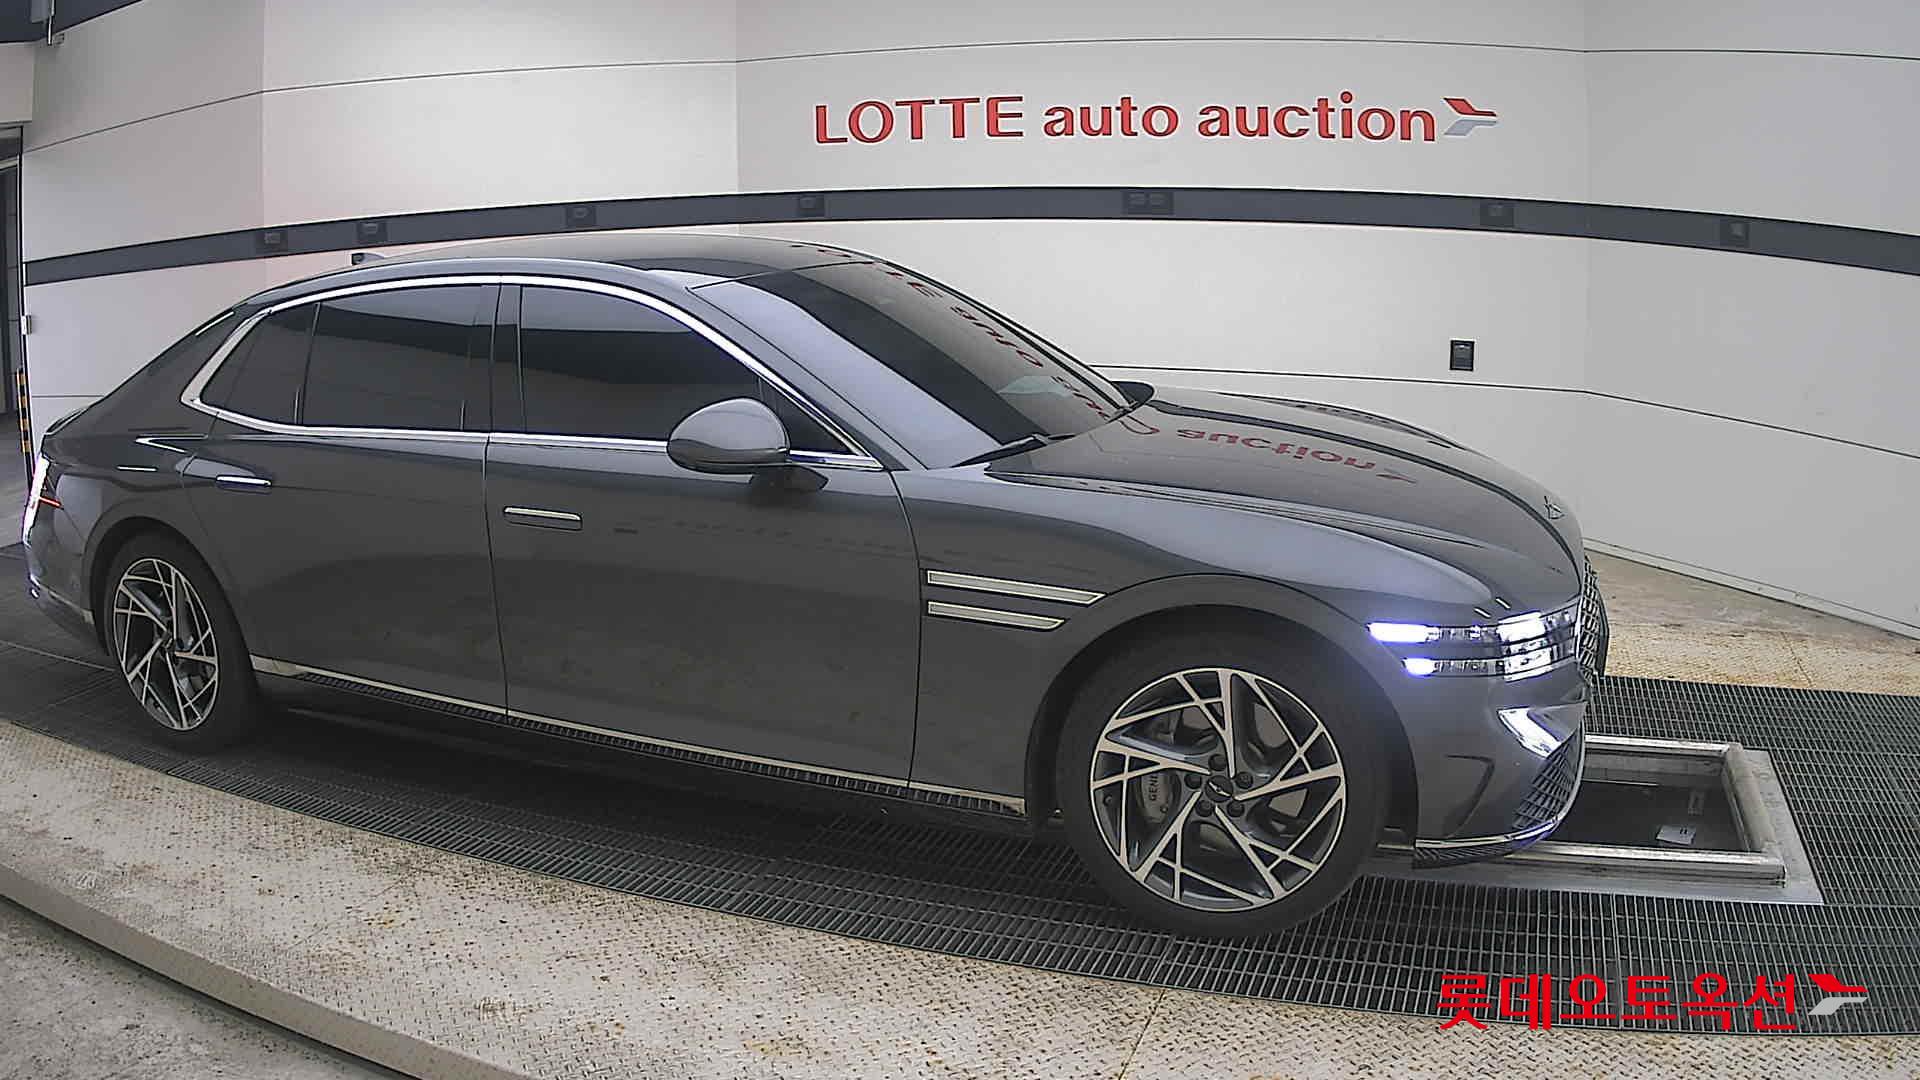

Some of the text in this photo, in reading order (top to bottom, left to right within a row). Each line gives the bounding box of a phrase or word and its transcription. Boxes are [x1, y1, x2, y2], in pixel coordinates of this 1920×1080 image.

[815, 91, 1437, 143] LOTTE auto auction
